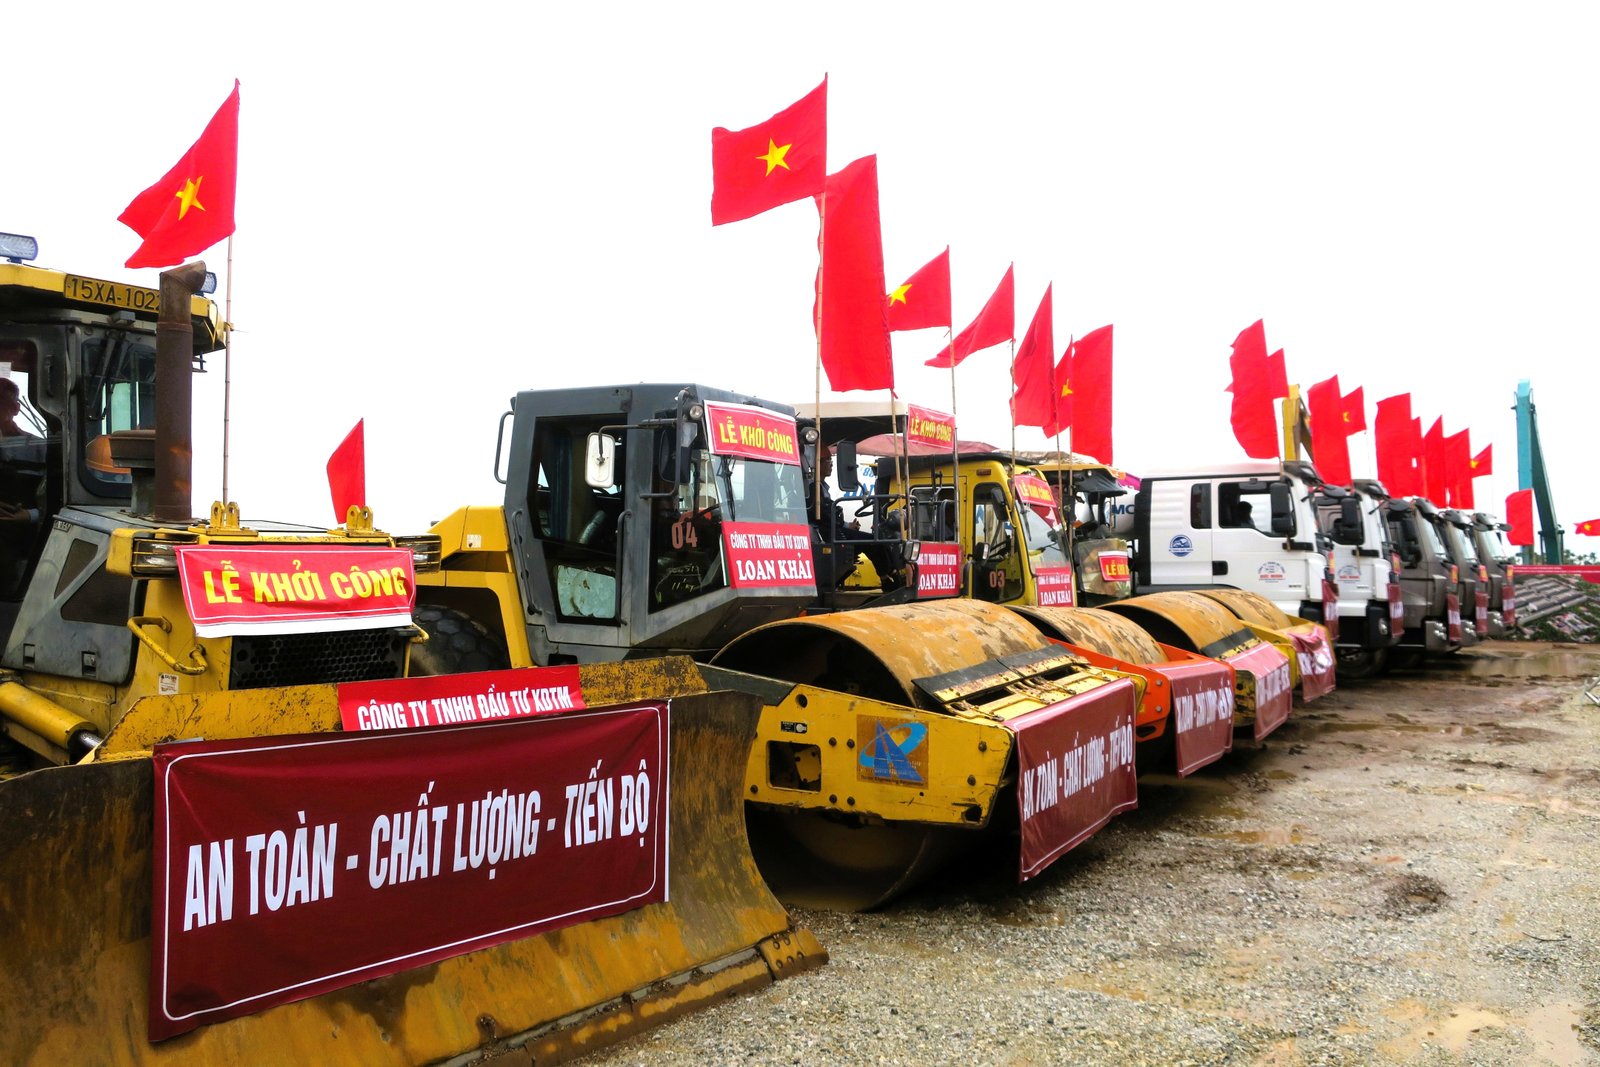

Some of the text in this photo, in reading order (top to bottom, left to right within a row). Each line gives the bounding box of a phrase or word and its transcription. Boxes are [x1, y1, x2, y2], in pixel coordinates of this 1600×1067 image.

[71, 278, 160, 310] 15XA-102
[719, 415, 794, 454] LỄ KHỞI CÔNG
[671, 521, 698, 550] 04
[203, 559, 407, 604] LỄ KHỞI CÔNG
[736, 559, 776, 581] LOAN
[917, 573, 937, 591] OAN
[989, 571, 1005, 588] 03
[357, 699, 408, 731] CÔNG
[408, 699, 430, 727] TY
[431, 695, 477, 725] TNHH
[476, 683, 511, 719] ĐẦU
[510, 687, 531, 715] TƯ
[1036, 750, 1058, 813] TOÀN
[1063, 730, 1083, 799] CHẤT
[1083, 735, 1105, 793] LƯỢNG
[183, 838, 234, 932] AN
[245, 810, 338, 916] TOÀN
[368, 780, 449, 890] CHẤT
[452, 788, 542, 880] LƯỢNG
[564, 759, 614, 849] TIẾN
[619, 758, 650, 848] ĐỘ
